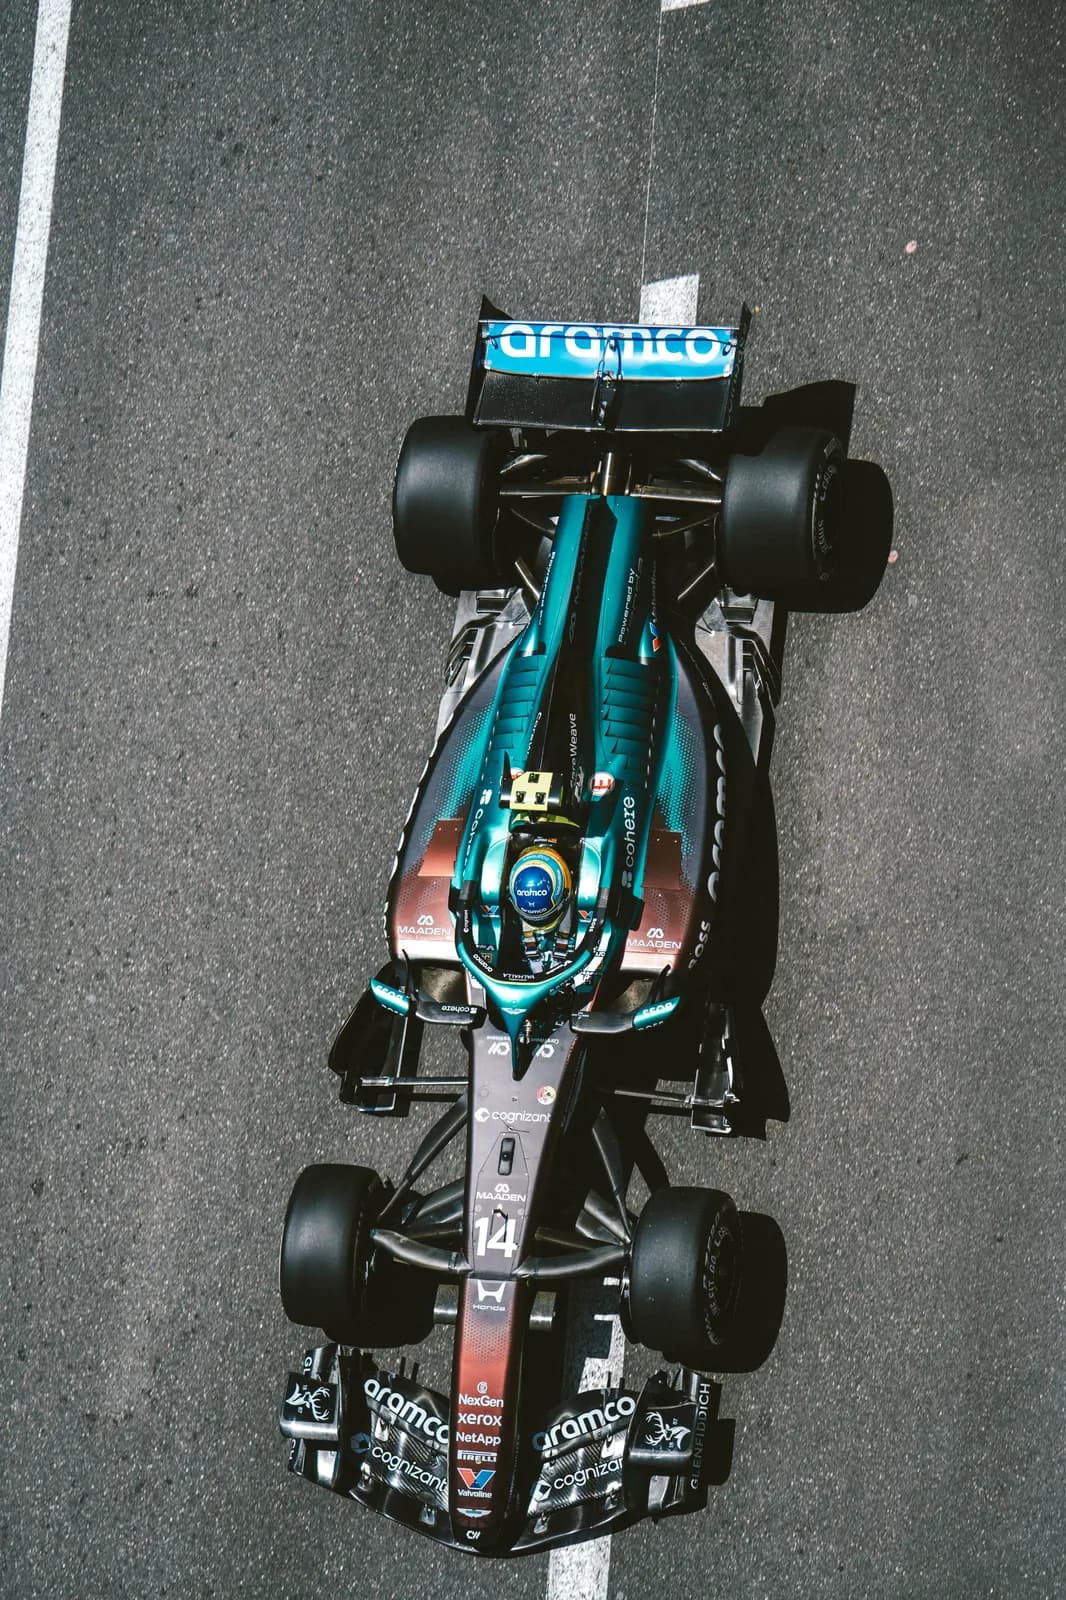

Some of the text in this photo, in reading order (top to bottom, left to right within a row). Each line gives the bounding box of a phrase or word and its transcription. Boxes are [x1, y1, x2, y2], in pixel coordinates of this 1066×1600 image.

[501, 324, 720, 363] aramco
[618, 586, 632, 642] Powered
[624, 796, 635, 868] cohere
[516, 888, 547, 897] aramco
[398, 925, 451, 937] MAADEN
[626, 938, 682, 950] MAADEN
[473, 953, 494, 973] aramco
[491, 1111, 553, 1123] cognizant
[476, 1191, 527, 1202] MAADEN
[474, 1217, 518, 1258] 14
[472, 1304, 506, 1312] Honda
[458, 1394, 504, 1408] NexGen
[363, 1378, 449, 1444] aramco
[457, 1412, 502, 1427] xerox
[532, 1396, 636, 1451] aramco
[455, 1432, 502, 1447] NetApp
[690, 1383, 711, 1490] GLENFIDDICH
[457, 1450, 498, 1463] PIRELLI
[371, 1446, 447, 1492] cognizant
[457, 1489, 493, 1499] Valvoline
